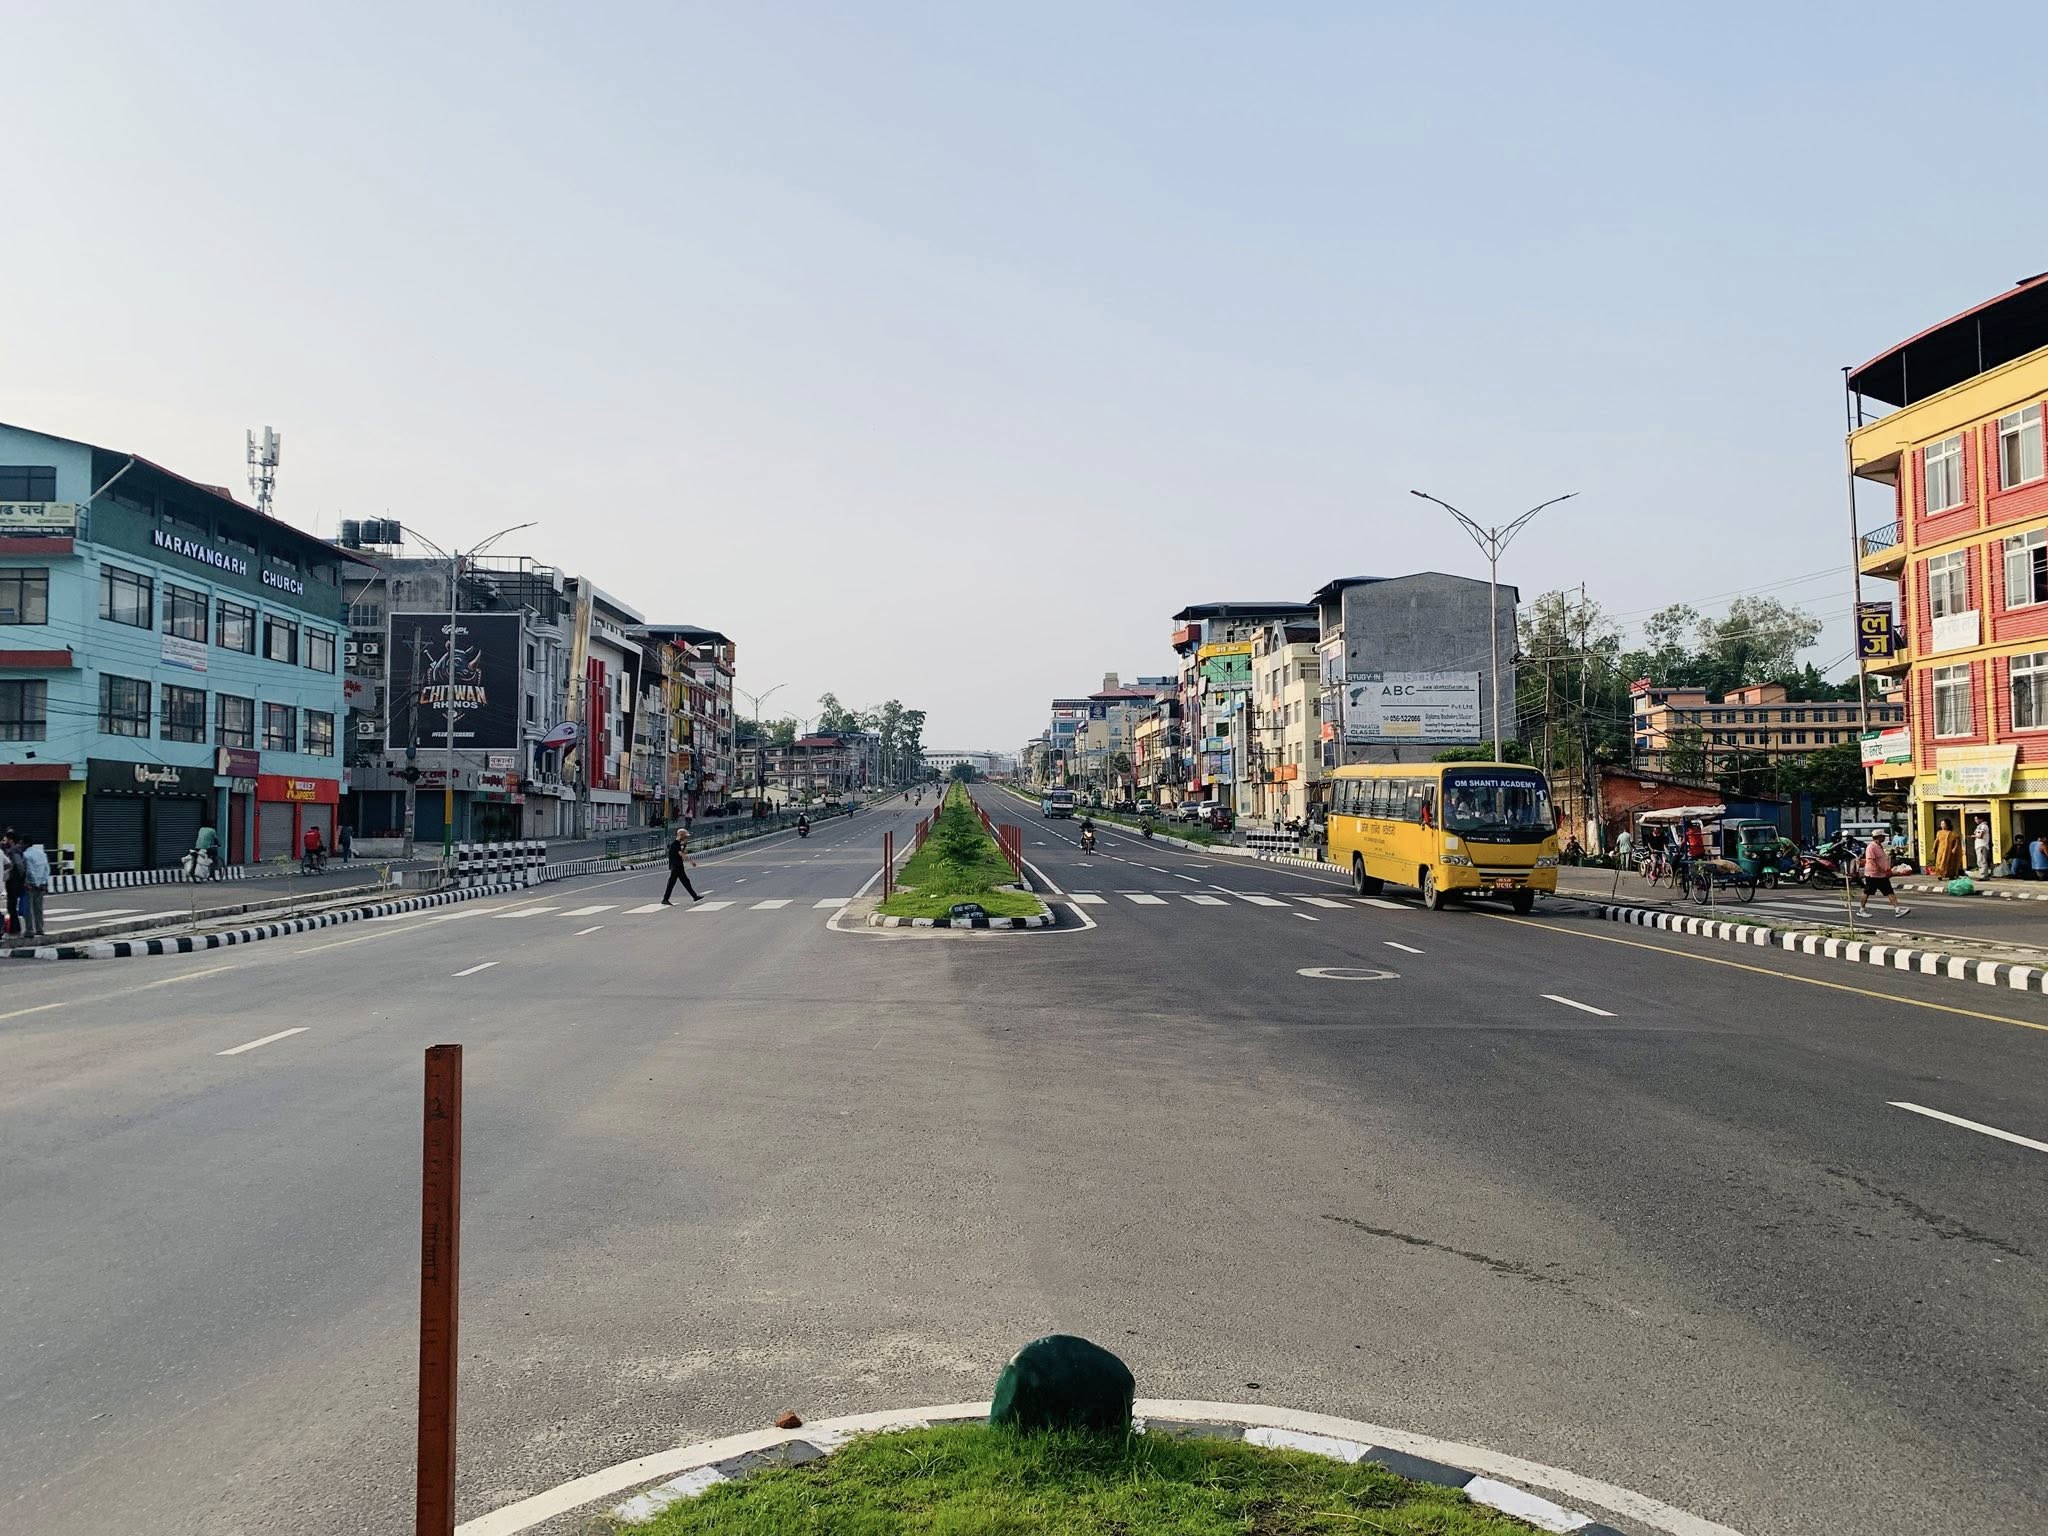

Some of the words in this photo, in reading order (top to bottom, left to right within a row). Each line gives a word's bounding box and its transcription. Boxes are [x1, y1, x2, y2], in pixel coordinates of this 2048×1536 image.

[154, 529, 247, 576] NARAYANGARH
[262, 569, 303, 596] CHURCH
[1381, 685, 1416, 696] ABC
[433, 701, 478, 709] RHNOS
[1500, 780, 1536, 788] ACADEMY
